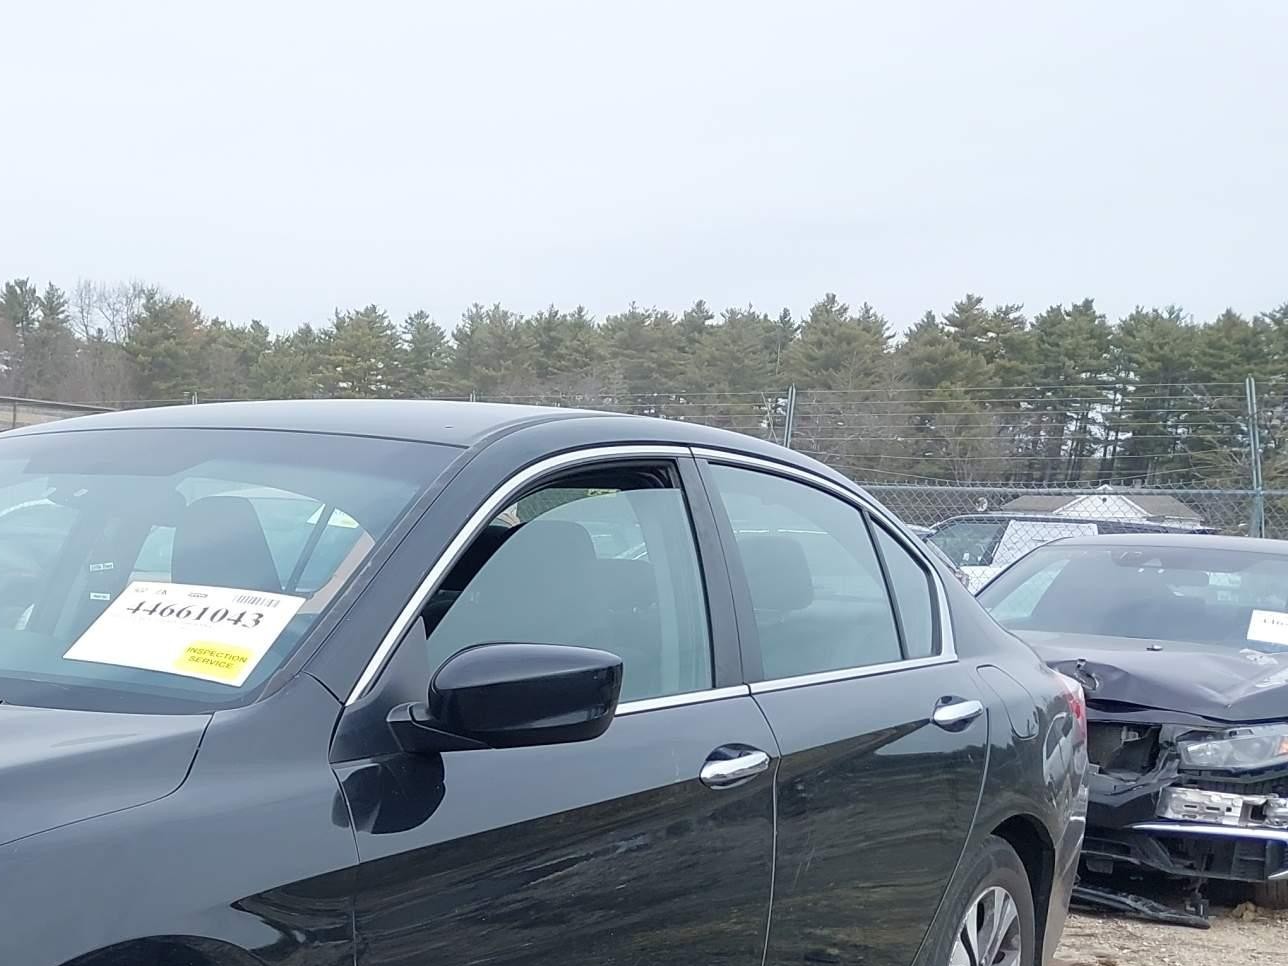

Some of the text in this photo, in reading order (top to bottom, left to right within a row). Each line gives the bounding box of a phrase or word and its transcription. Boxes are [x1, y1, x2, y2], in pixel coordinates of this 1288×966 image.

[126, 600, 264, 628] 44661043
[186, 647, 248, 663] INSPECTION
[188, 656, 234, 669] SERVICE
